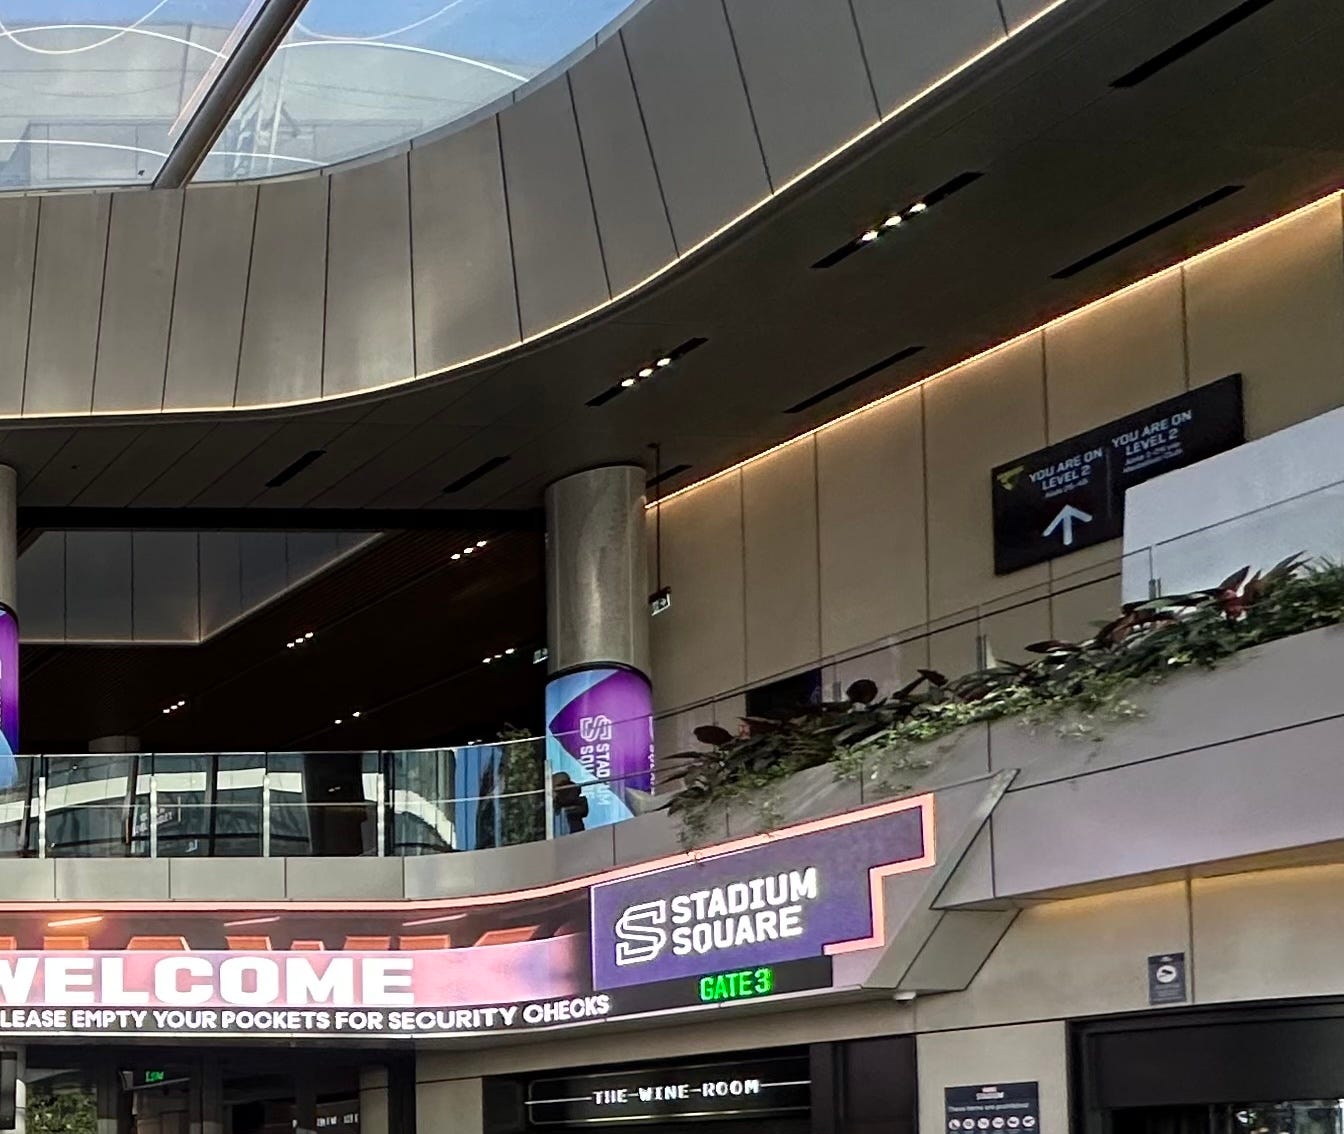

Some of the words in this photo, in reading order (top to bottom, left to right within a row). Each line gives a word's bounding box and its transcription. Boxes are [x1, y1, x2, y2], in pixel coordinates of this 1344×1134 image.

[1112, 430, 1140, 448] YOU
[1141, 419, 1169, 437] ARE
[1171, 410, 1192, 426] ON
[1126, 434, 1167, 456] LEVEL
[1168, 427, 1179, 440] 2
[1028, 465, 1055, 483] YOU
[1056, 456, 1081, 473] ARE
[1084, 447, 1103, 462] ON
[1042, 469, 1079, 490] LEVEL
[1081, 464, 1092, 476] 2
[672, 867, 818, 924] STADIUM
[672, 905, 804, 956] SQUARE
[700, 971, 753, 1001] GATE
[755, 968, 772, 993] 3
[72, 1010, 148, 1028] EMPTY
[153, 1010, 217, 1029] YOUR
[222, 1010, 330, 1029] POCKETS
[335, 1011, 383, 1029] FOR
[388, 1005, 518, 1030] SECURITY
[522, 994, 610, 1025] CHECKS
[593, 1089, 628, 1105] THE
[638, 1084, 690, 1102] WINE
[702, 1079, 760, 1097] ROOM
